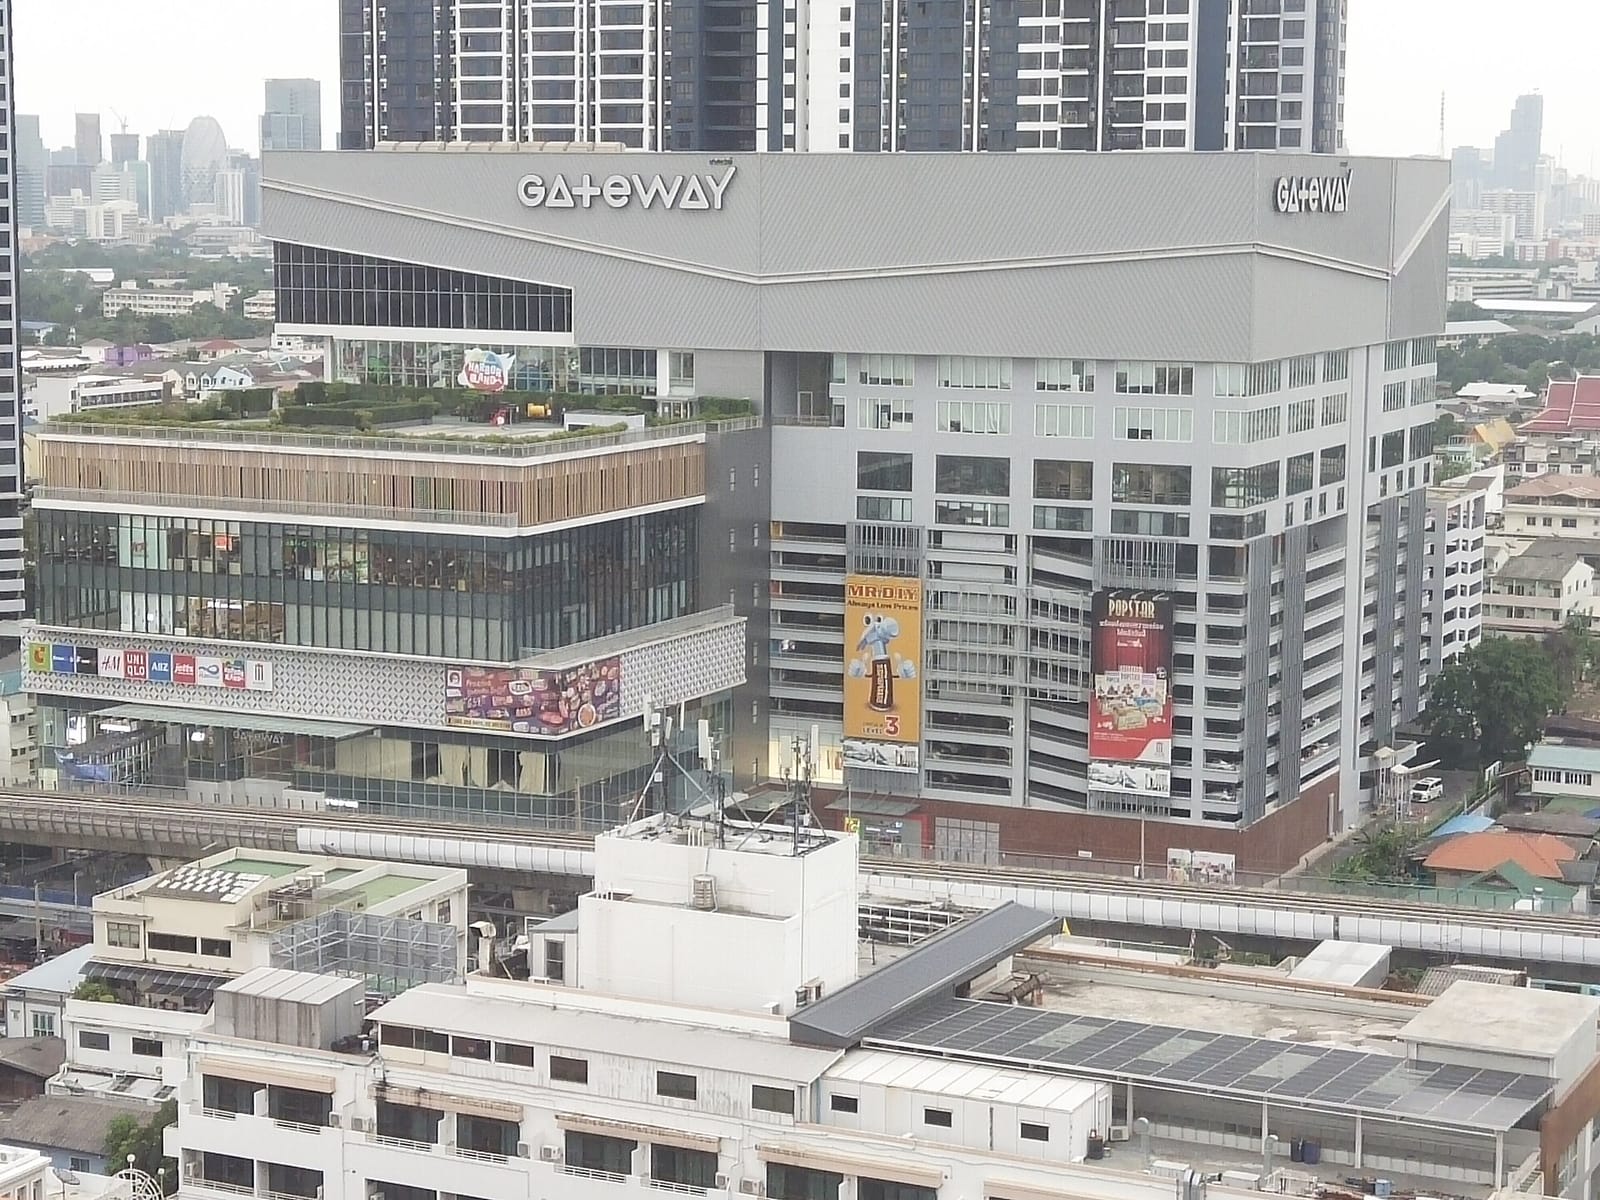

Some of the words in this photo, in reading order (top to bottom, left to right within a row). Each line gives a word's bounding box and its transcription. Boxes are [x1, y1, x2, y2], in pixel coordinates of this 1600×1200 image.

[847, 600, 875, 609] Always
[1108, 598, 1155, 619] POPSTAR
[126, 653, 144, 665] UNI
[126, 665, 145, 676] QLO
[885, 716, 899, 735] 3
